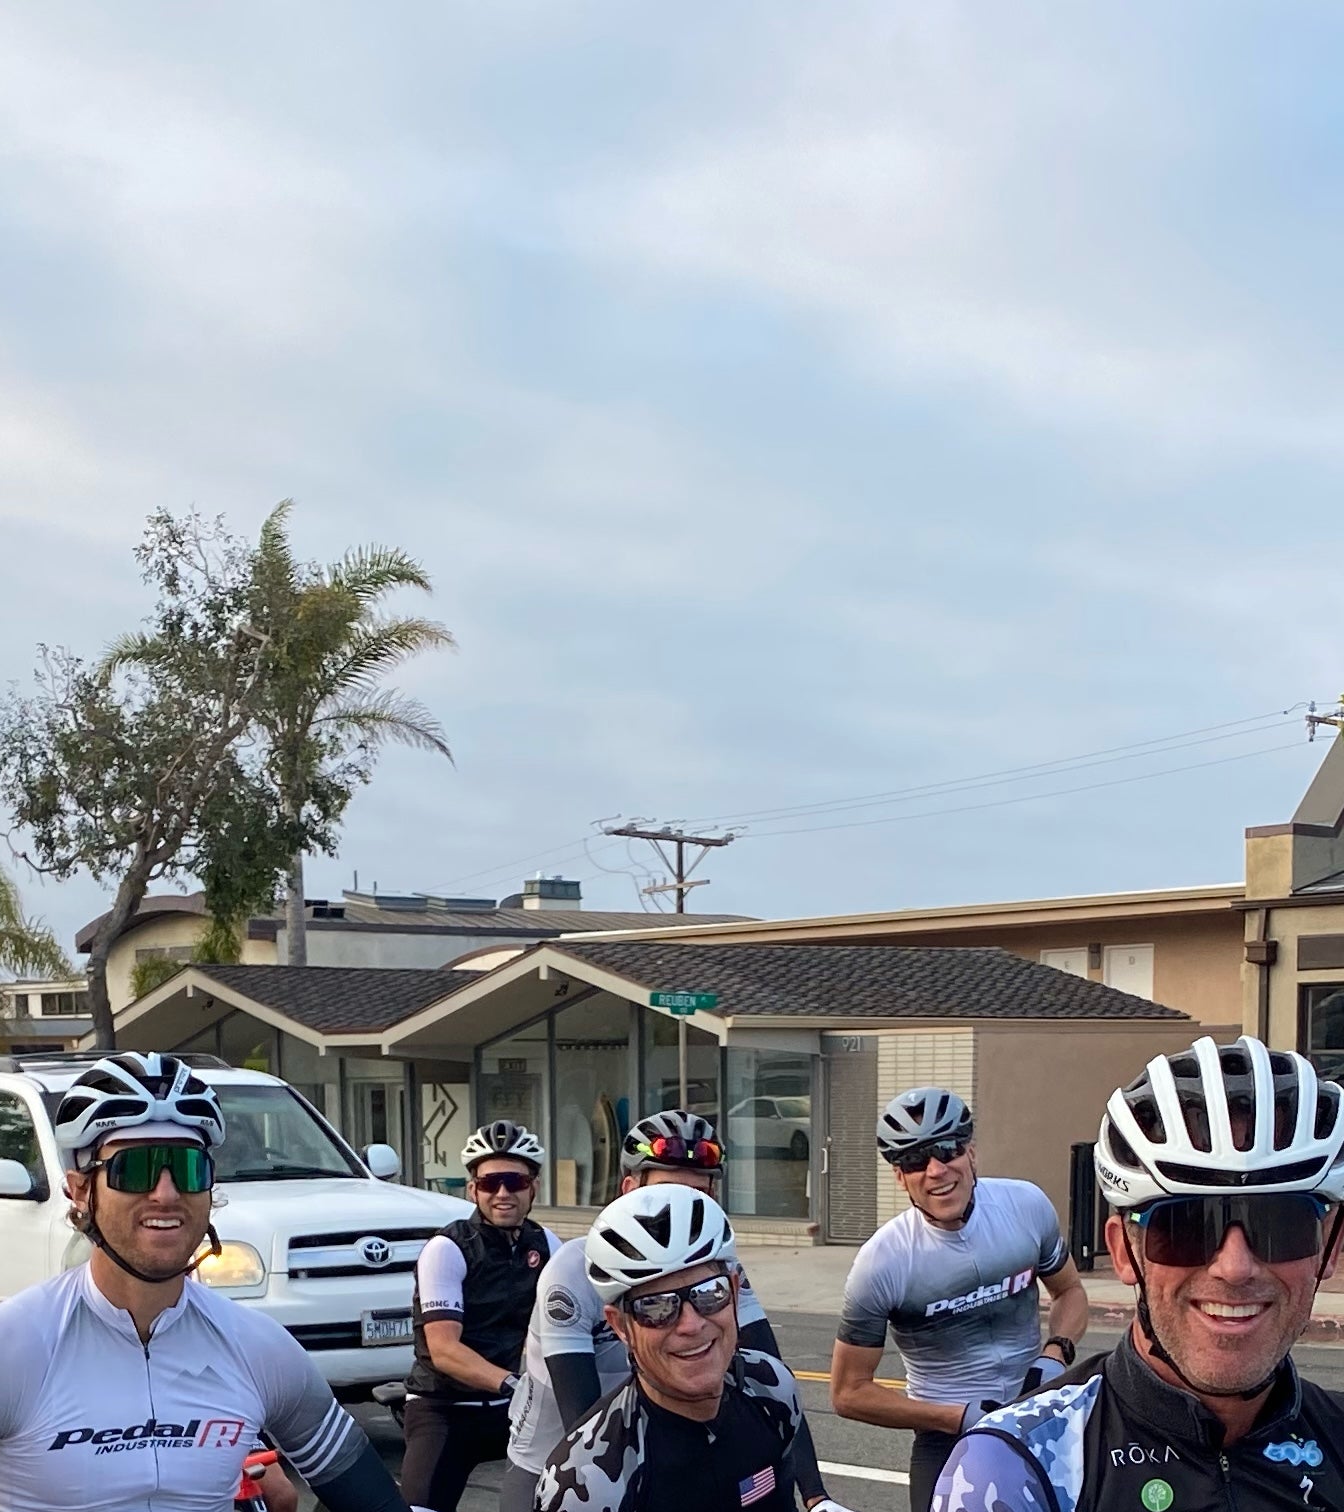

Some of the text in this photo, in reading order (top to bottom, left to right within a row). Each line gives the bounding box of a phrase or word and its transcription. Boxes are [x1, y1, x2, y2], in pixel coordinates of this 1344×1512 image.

[658, 994, 697, 1007] REUBEN
[842, 1036, 862, 1053] 921
[952, 1291, 1008, 1315] INDUSTRIES
[366, 1320, 413, 1339] 5MDH71
[95, 1439, 194, 1455] INDUSTRIES
